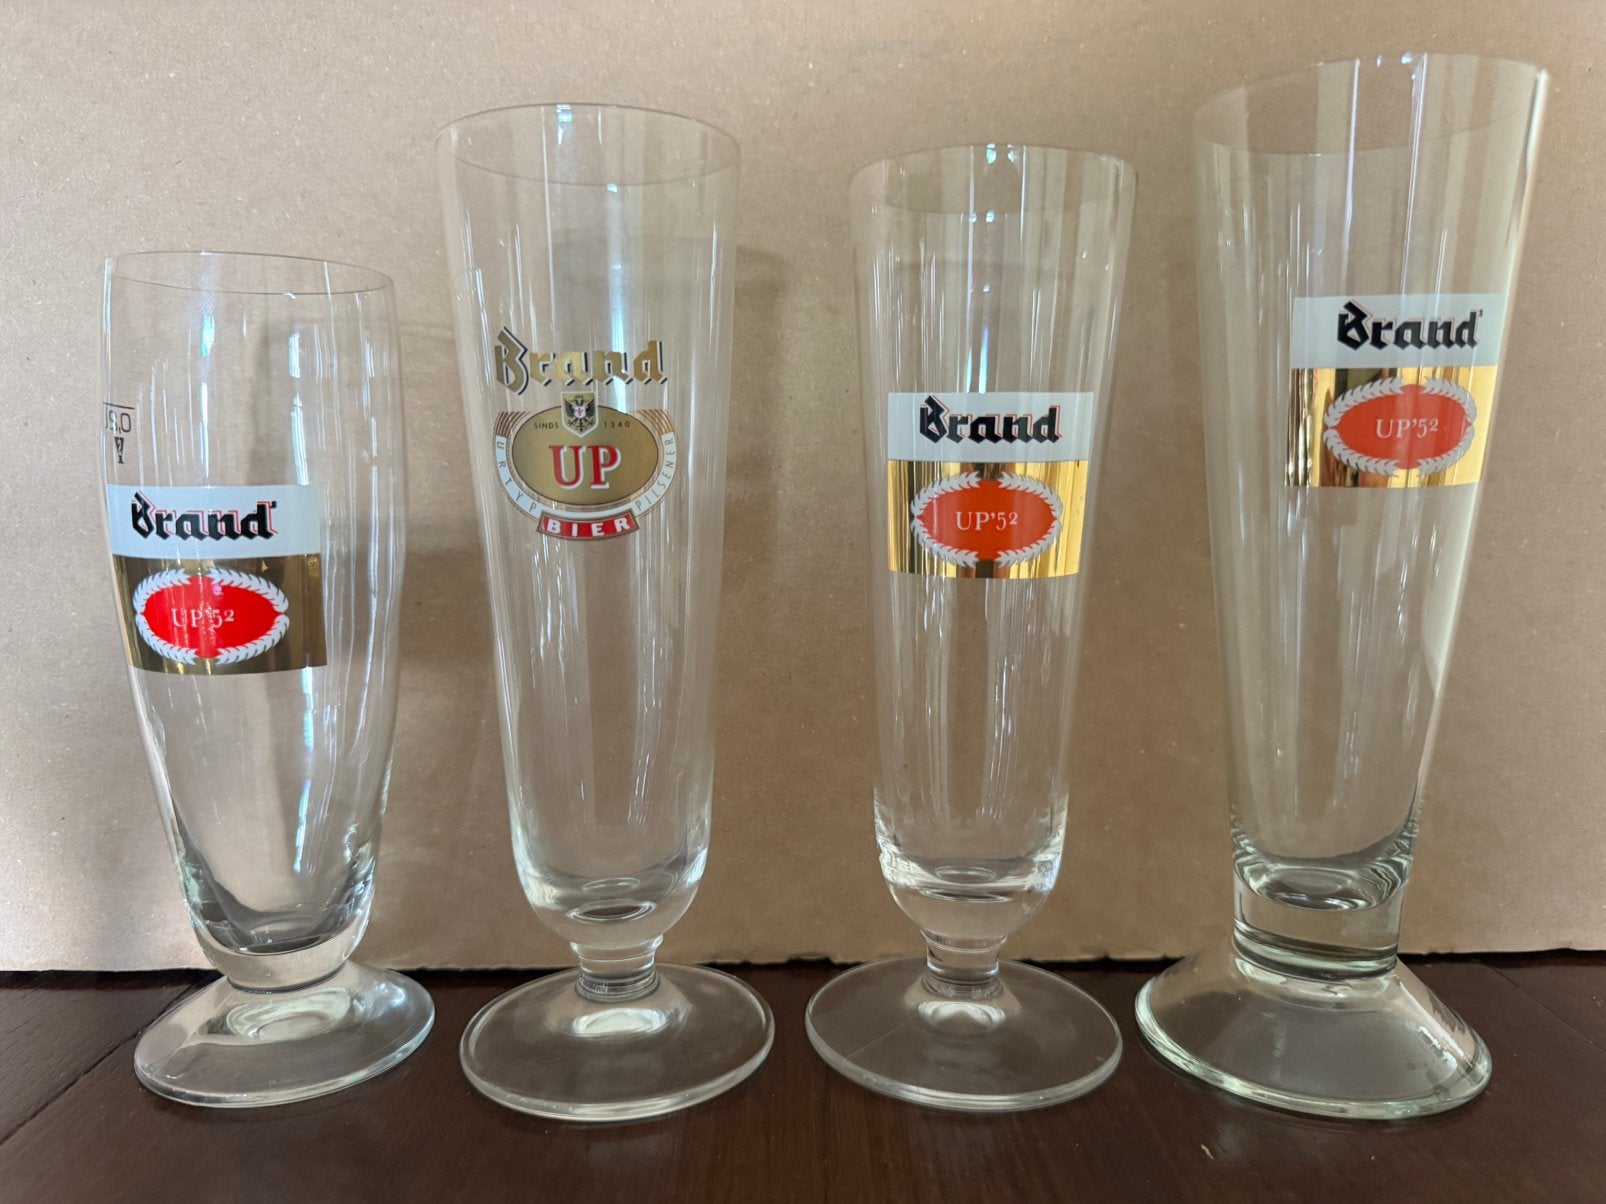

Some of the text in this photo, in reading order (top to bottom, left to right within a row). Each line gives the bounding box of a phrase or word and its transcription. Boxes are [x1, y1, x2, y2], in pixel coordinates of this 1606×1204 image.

[1337, 300, 1481, 350] Brand
[494, 327, 667, 395] Brand
[533, 420, 631, 430] SINDS 1340
[919, 395, 1063, 444] Brand
[1375, 418, 1439, 439] UP'52
[548, 444, 622, 490] UP
[635, 436, 676, 511] PILSENER
[131, 490, 278, 541] Brand
[546, 514, 631, 537] BIER
[955, 511, 1019, 531] UP'52
